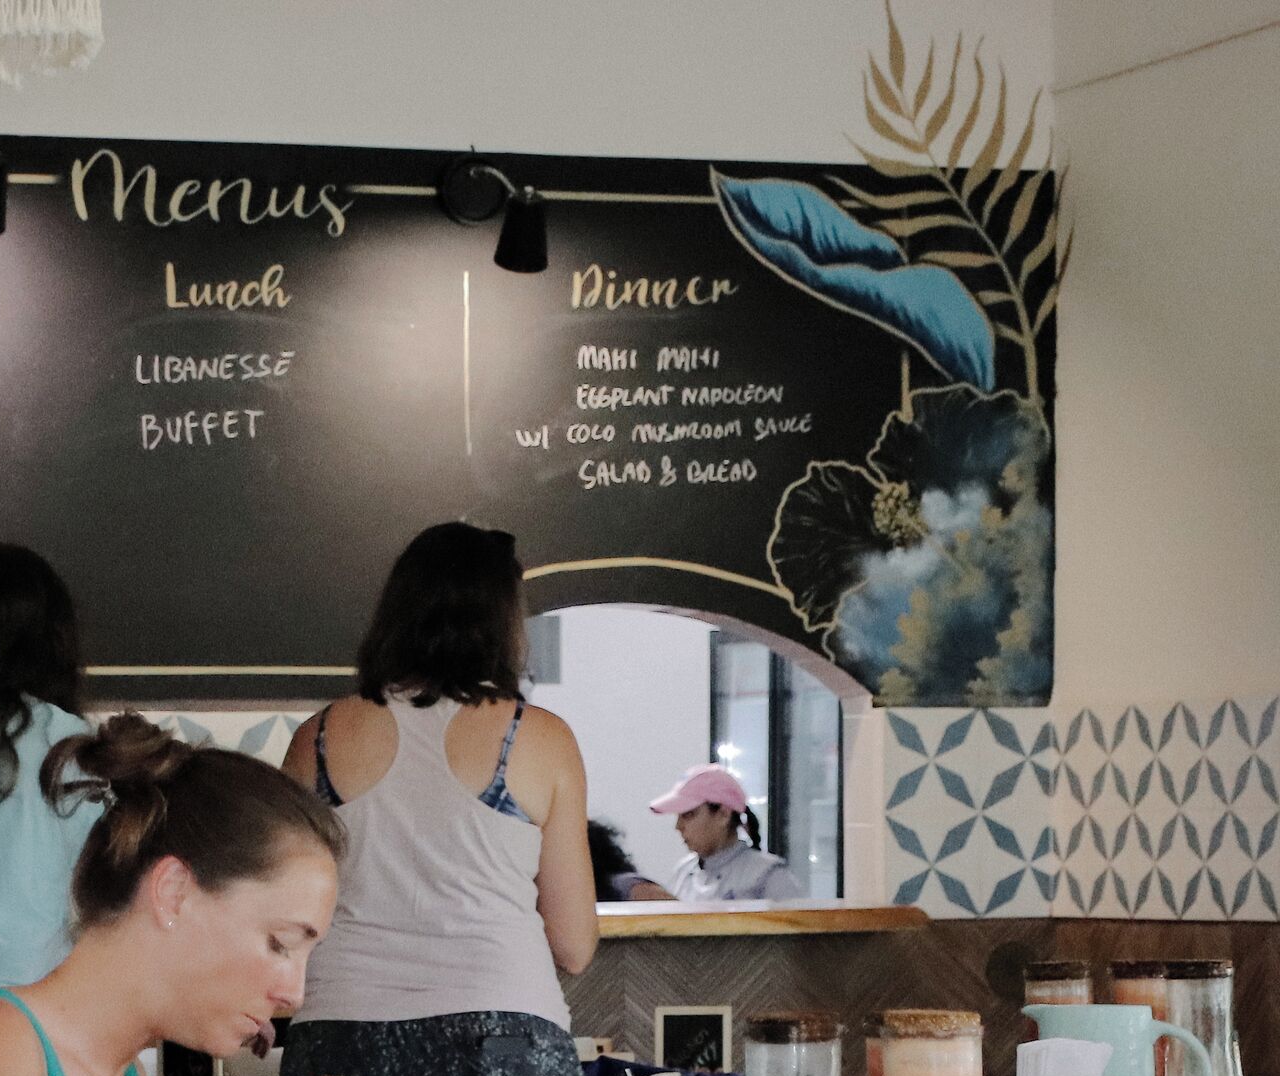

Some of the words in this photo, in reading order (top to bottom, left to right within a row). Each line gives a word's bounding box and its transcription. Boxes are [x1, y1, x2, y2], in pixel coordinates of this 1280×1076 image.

[71, 149, 353, 237] Menus
[165, 262, 293, 311] Lunch
[572, 263, 739, 310] Dinner
[136, 351, 296, 385] LIBANESSE
[577, 345, 638, 372] MAHI
[657, 346, 720, 372] MAHI
[577, 384, 674, 411] EGGPLANT
[681, 384, 784, 407] NAPOLEON
[141, 409, 265, 450] BUFFET
[566, 423, 615, 444] COCO
[631, 417, 742, 444] MUSHROOM
[754, 413, 813, 441] SAUCE
[578, 458, 651, 490] SALAD
[658, 454, 678, 488] &
[686, 458, 757, 485] BREAD
